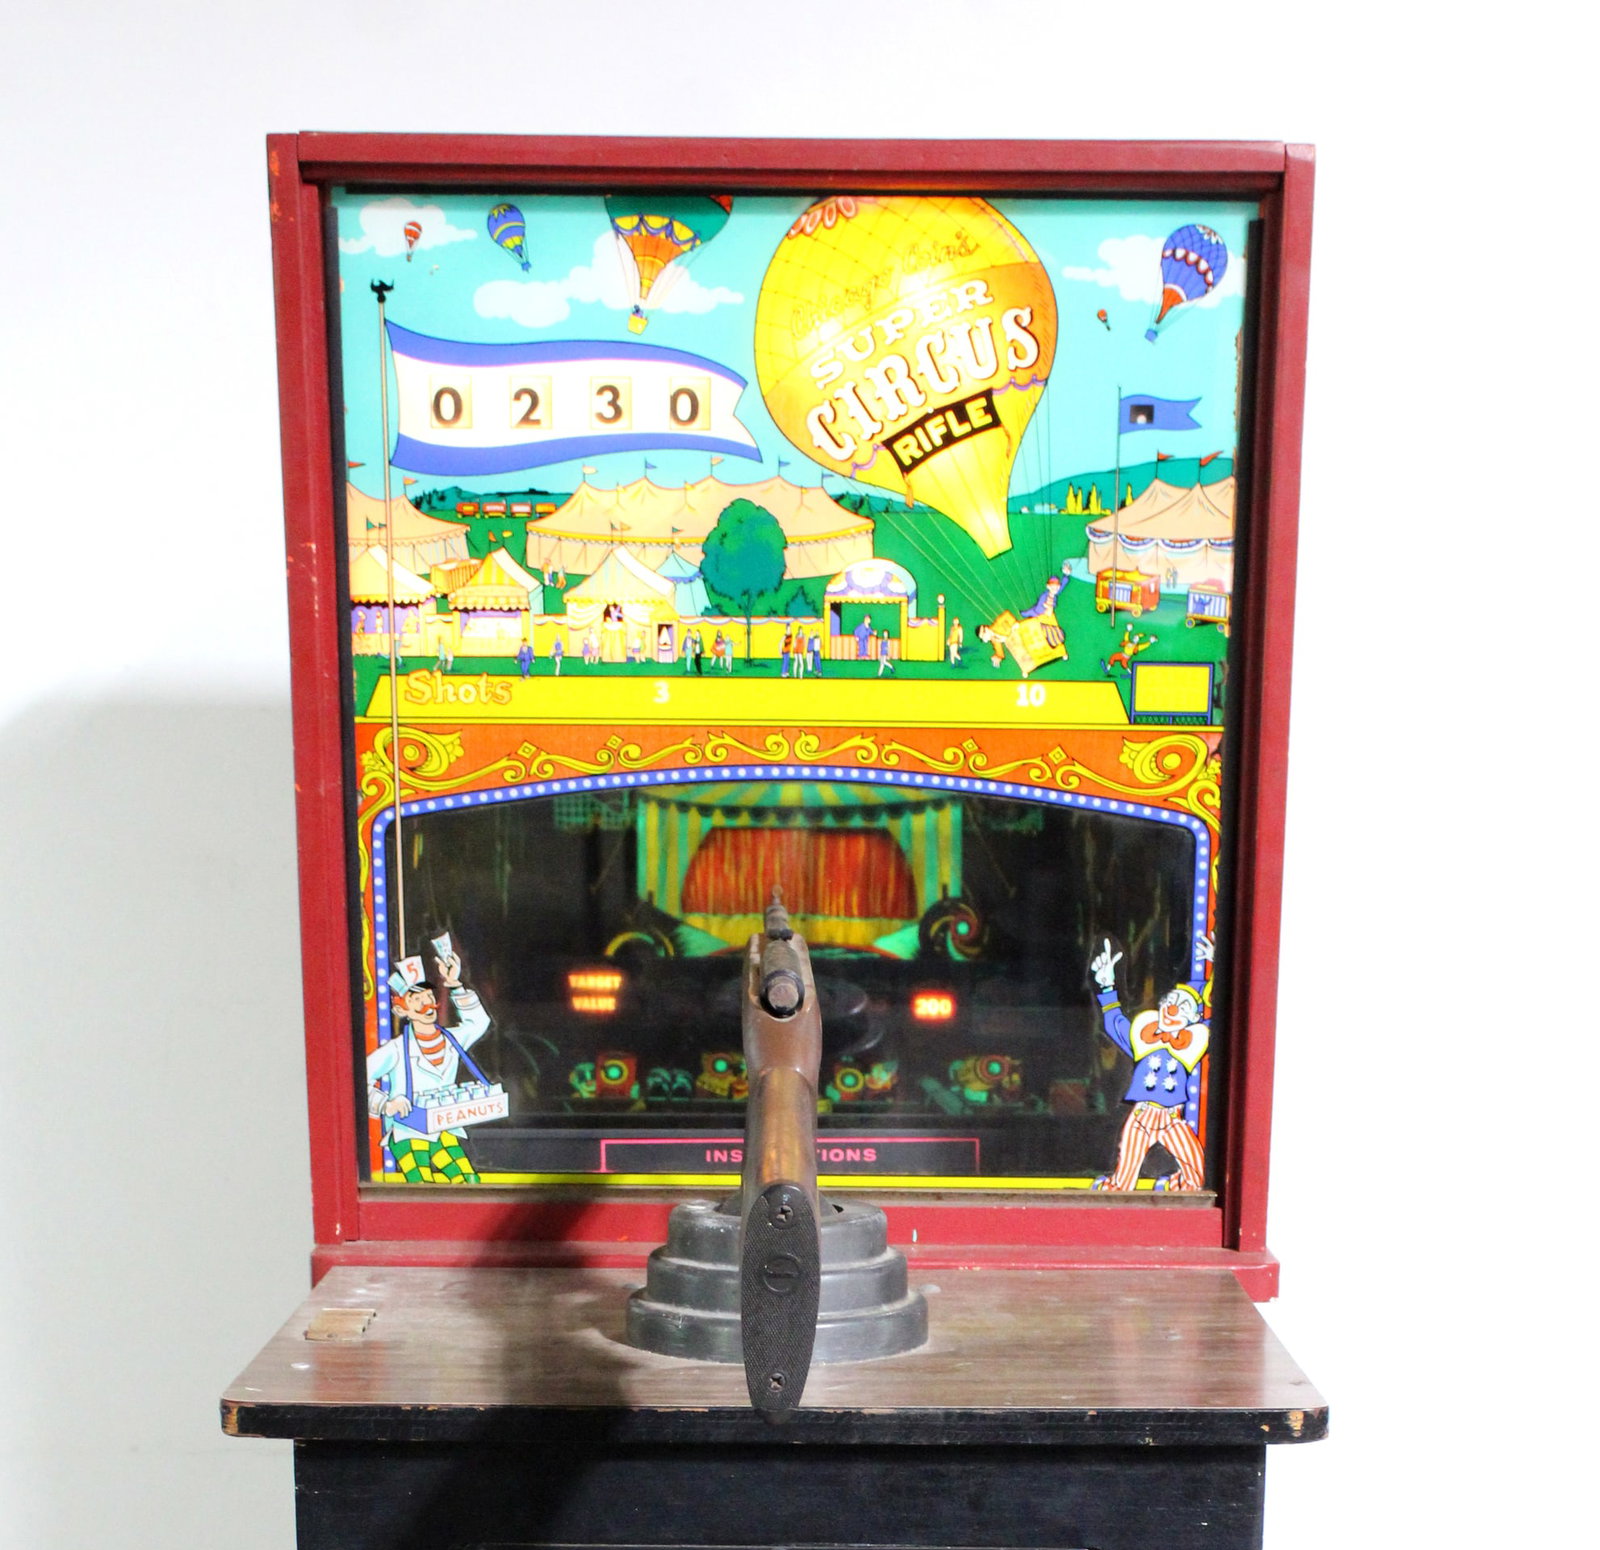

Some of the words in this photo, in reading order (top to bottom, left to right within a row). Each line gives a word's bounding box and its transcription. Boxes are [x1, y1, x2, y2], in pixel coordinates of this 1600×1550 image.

[809, 279, 994, 390] SUPER
[806, 305, 1034, 461] CIRCUS
[893, 395, 994, 467] RIFLE
[404, 668, 512, 705] Shots
[653, 681, 670, 704] 3
[1016, 684, 1046, 707] 10
[406, 961, 419, 983] 5
[568, 974, 622, 989] TARGET
[572, 997, 616, 1011] VALUE
[915, 997, 953, 1017] 200
[436, 1101, 504, 1126] PEANUTS
[705, 1149, 877, 1163] INSIONS
